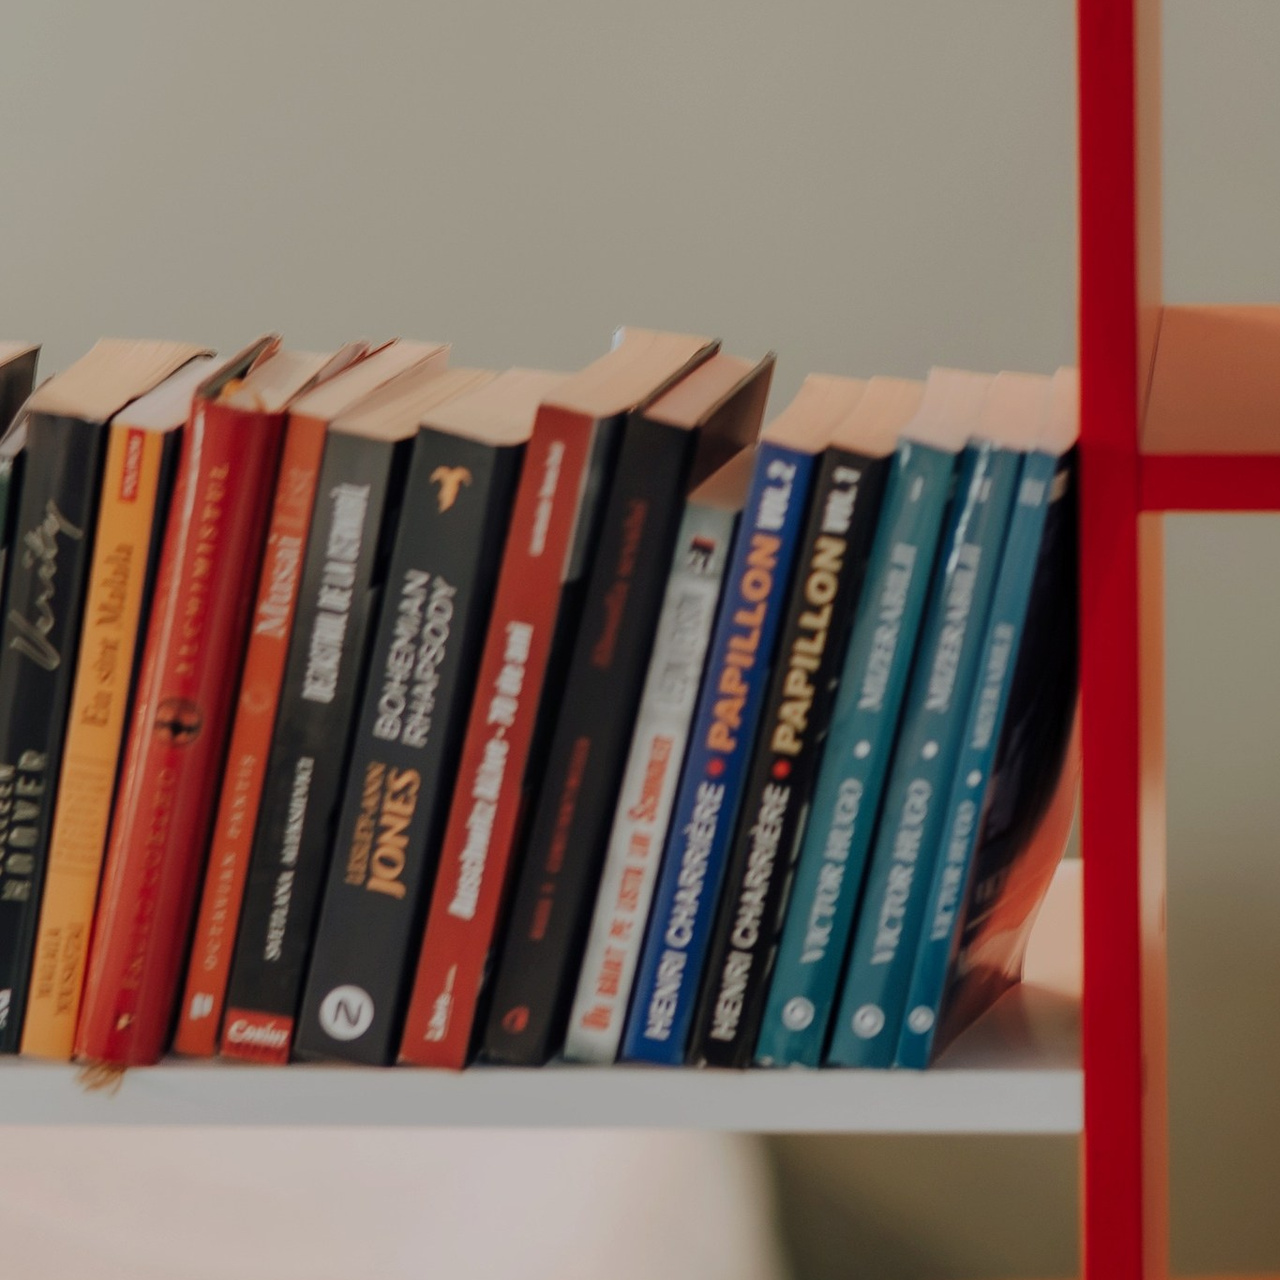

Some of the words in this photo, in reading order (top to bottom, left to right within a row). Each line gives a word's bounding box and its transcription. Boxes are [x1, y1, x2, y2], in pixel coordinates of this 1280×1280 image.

[174, 458, 231, 677] ALCHIMISTUL
[254, 532, 301, 640] Musai
[705, 532, 781, 754] PAPILLON
[770, 533, 846, 758] PAPILLON
[371, 566, 433, 743] BOHEMIAN
[399, 575, 458, 749] RHAPSODY
[201, 849, 238, 972] OCTAVIAN
[364, 764, 422, 900] JONES
[665, 779, 725, 951] CHARRIÈRE
[729, 779, 790, 951] CHARRIÈRE
[799, 861, 846, 968] VICTOR
[823, 775, 866, 862] HUGO
[868, 862, 914, 969] VICTOR
[891, 775, 934, 864] HUGO
[642, 948, 689, 1043] HENRI
[710, 948, 752, 1043] HENRI
